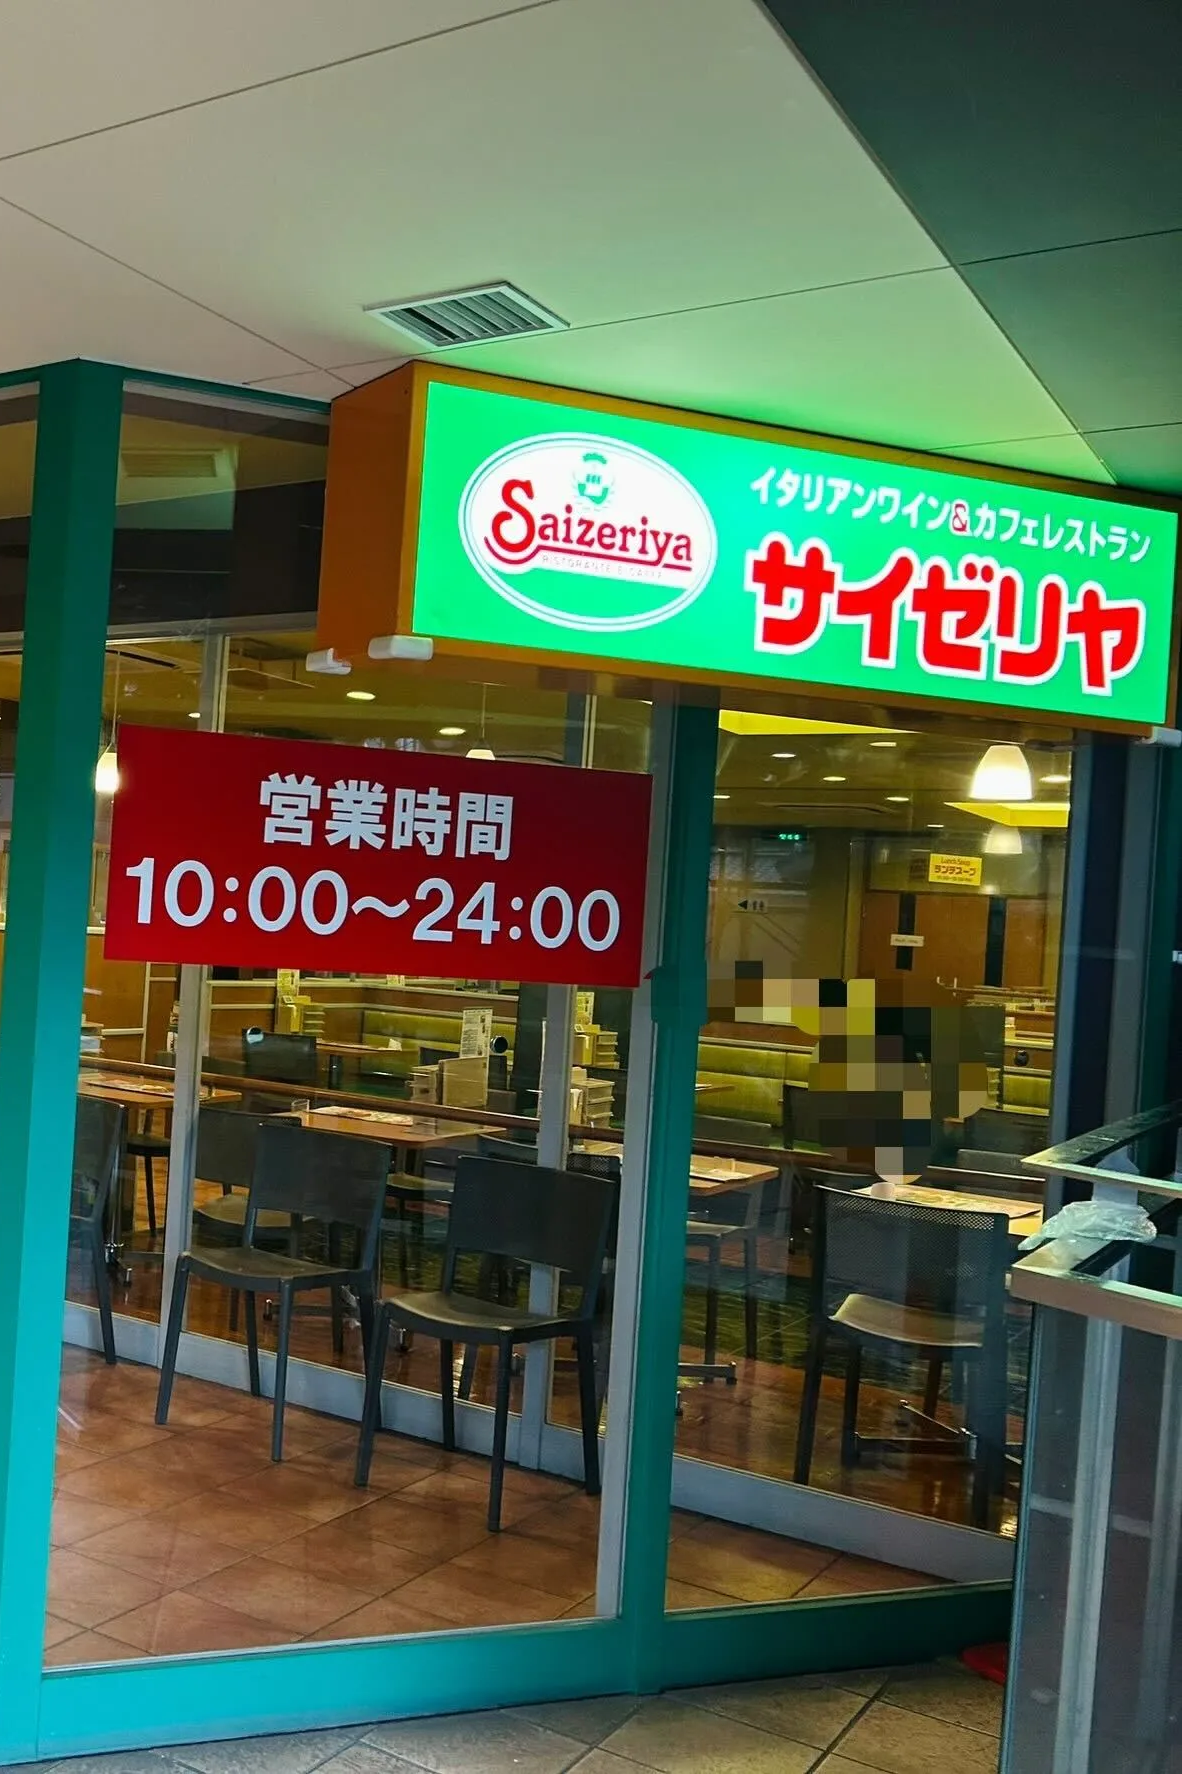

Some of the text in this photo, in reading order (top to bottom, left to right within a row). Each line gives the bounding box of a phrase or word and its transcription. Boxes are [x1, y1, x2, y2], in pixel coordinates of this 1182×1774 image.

[491, 478, 693, 567] Saizeriya
[750, 466, 1151, 563] イタリアンワイン&カフェレストラン
[750, 537, 1142, 692] サイゼリヤ
[260, 772, 514, 861] 営業時間
